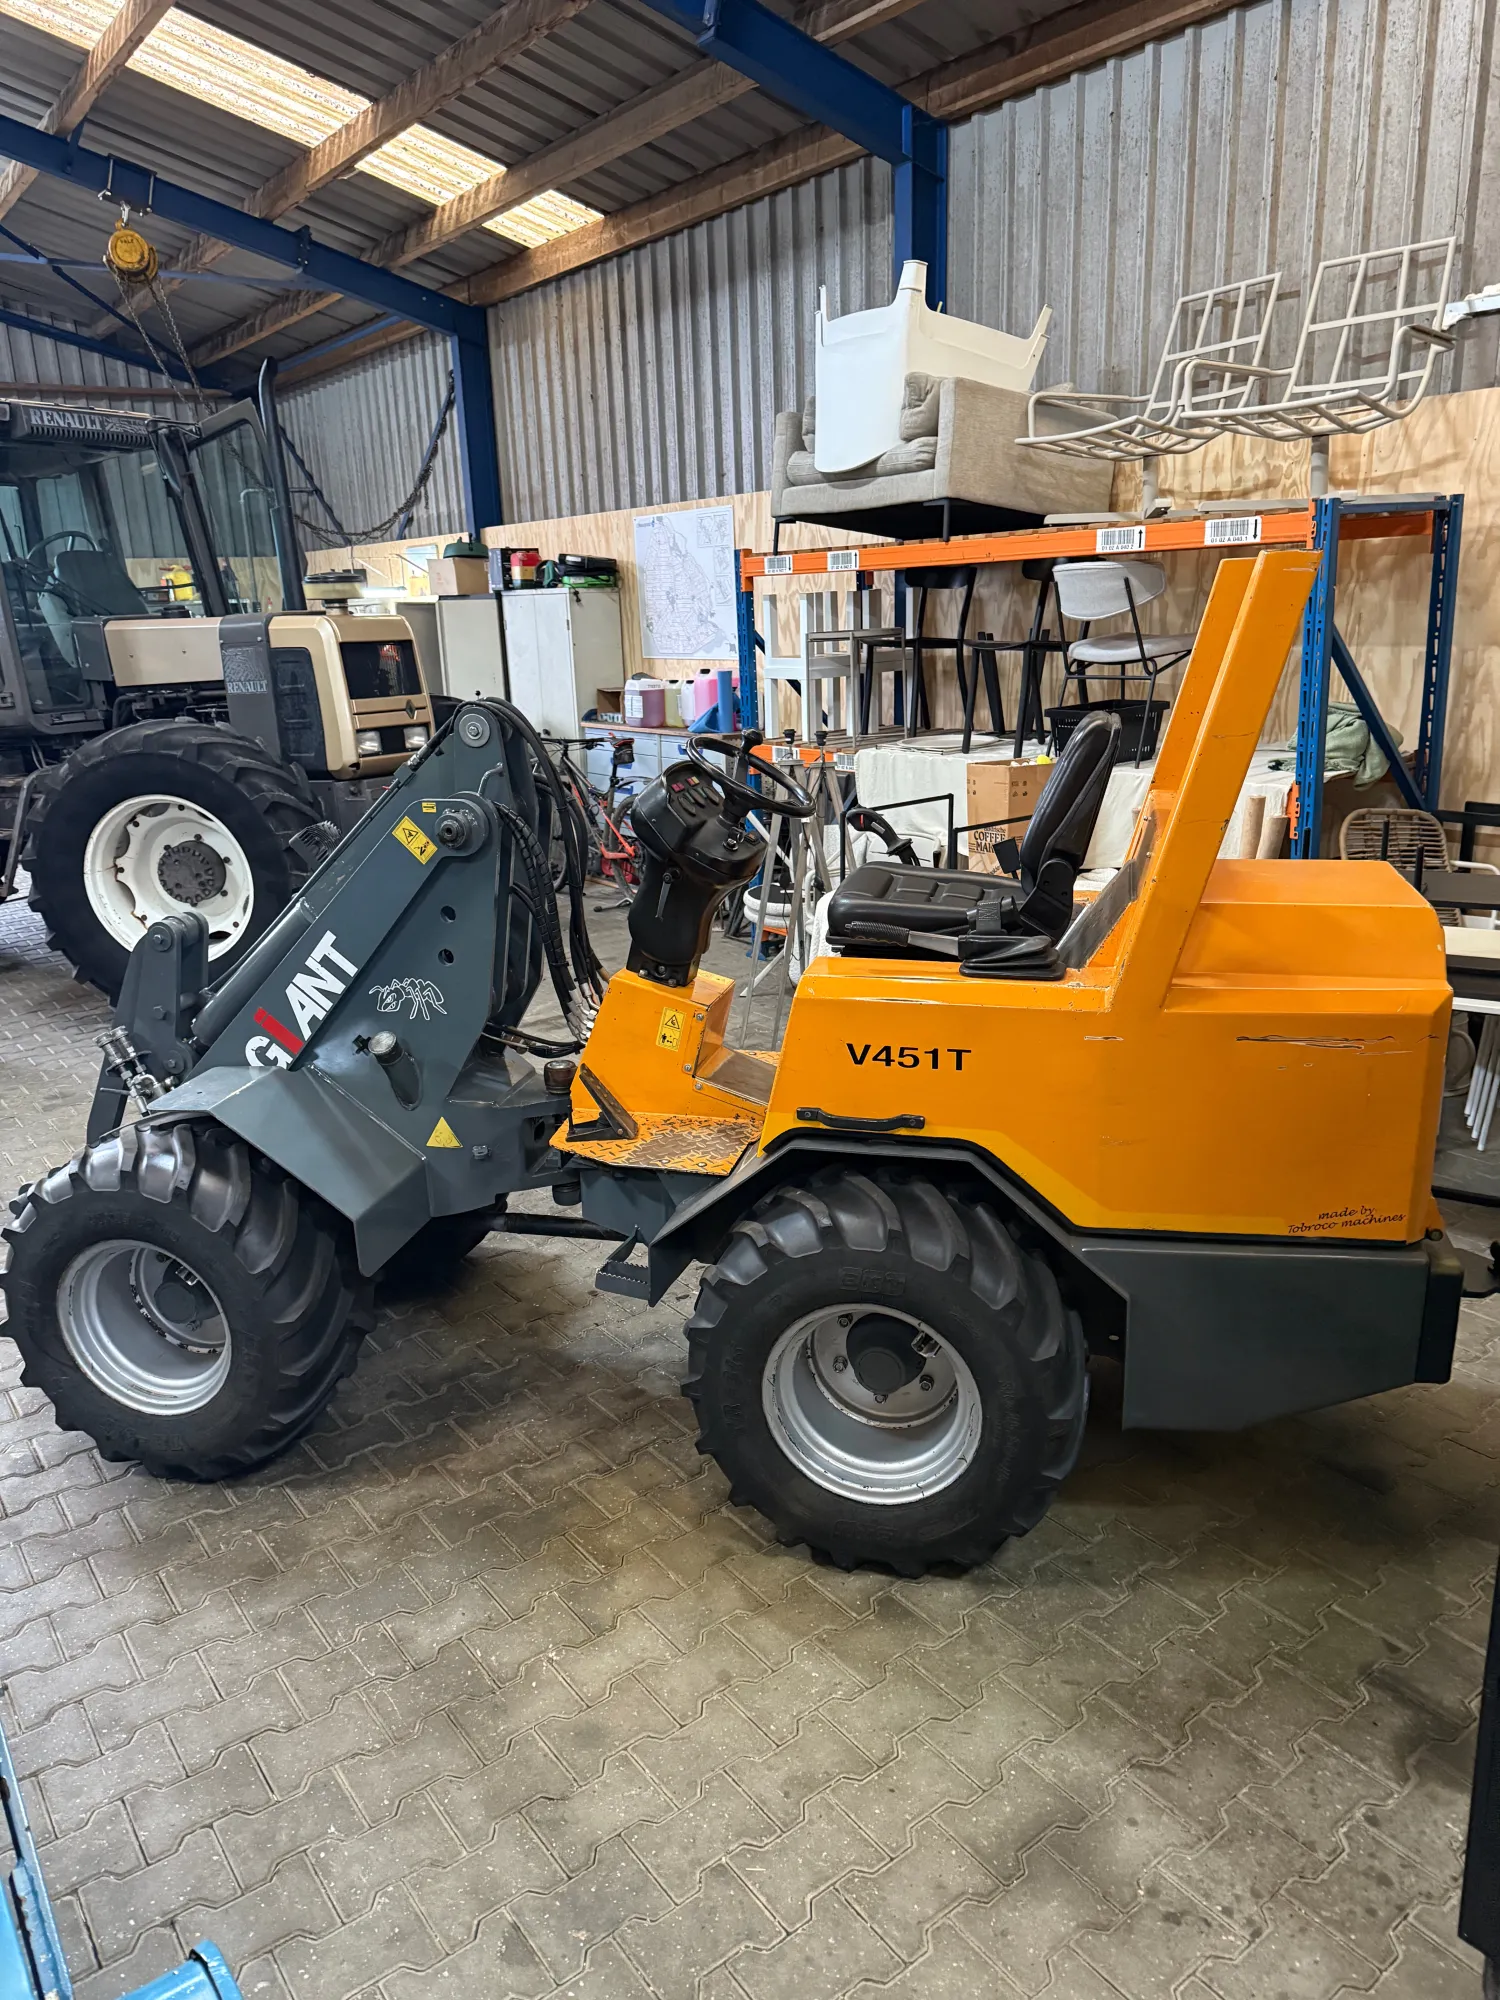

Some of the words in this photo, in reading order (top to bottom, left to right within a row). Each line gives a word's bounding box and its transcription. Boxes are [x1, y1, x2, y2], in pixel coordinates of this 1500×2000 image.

[29, 408, 102, 430] RENAULT
[226, 680, 267, 694] RENAULT
[973, 830, 1006, 843] COFFEE
[975, 840, 995, 853] MAK
[245, 930, 358, 1070] GIANT
[846, 1043, 971, 1071] V451T
[1318, 1206, 1357, 1220] made
[1360, 1205, 1375, 1216] by
[1288, 1222, 1339, 1234] Tobroco
[1341, 1213, 1406, 1228] machines
